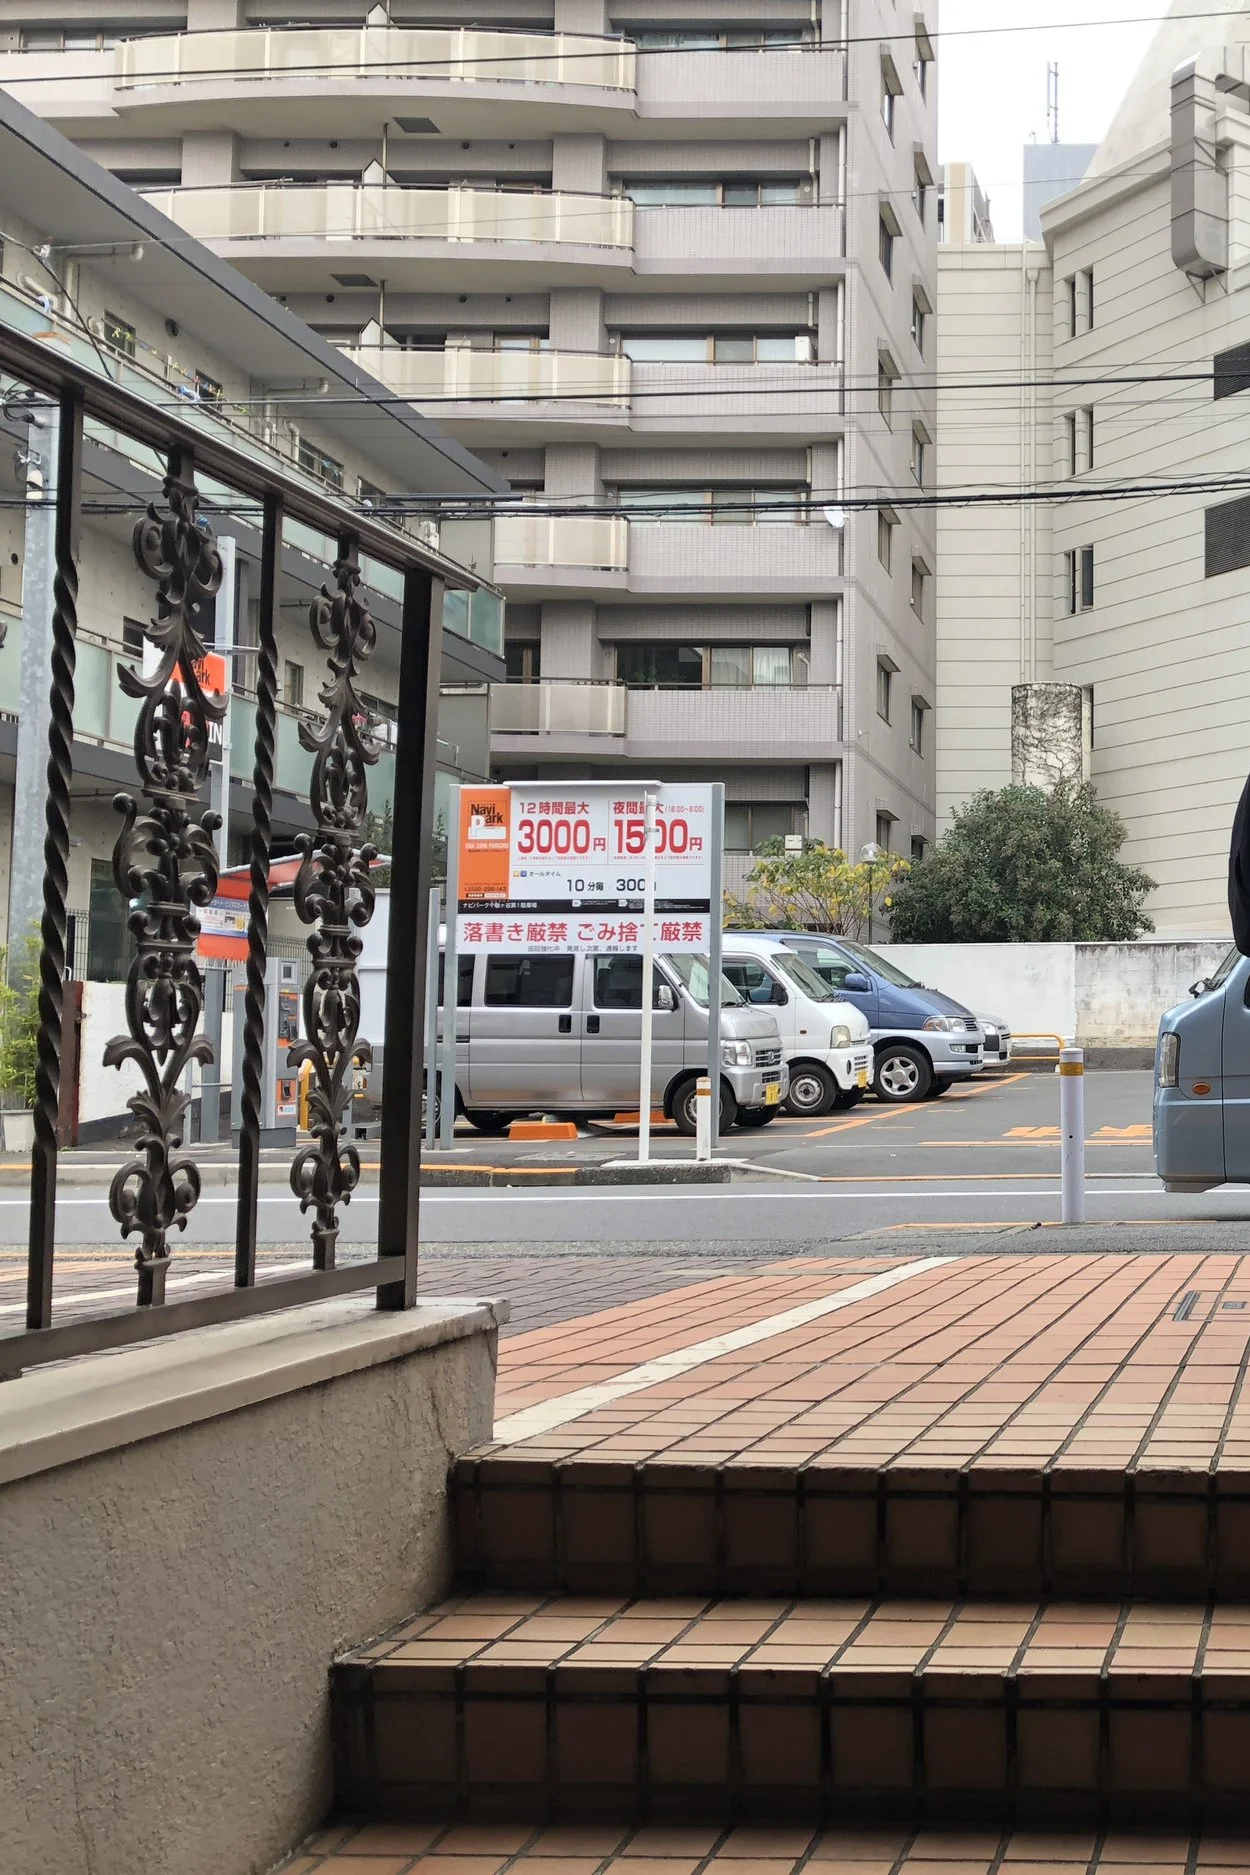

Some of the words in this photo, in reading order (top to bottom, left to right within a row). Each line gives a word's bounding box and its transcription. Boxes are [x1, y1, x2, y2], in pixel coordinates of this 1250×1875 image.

[470, 803, 496, 816] Navi
[519, 801, 590, 815] 12時間最大
[463, 922, 568, 942] 落書き厳禁
